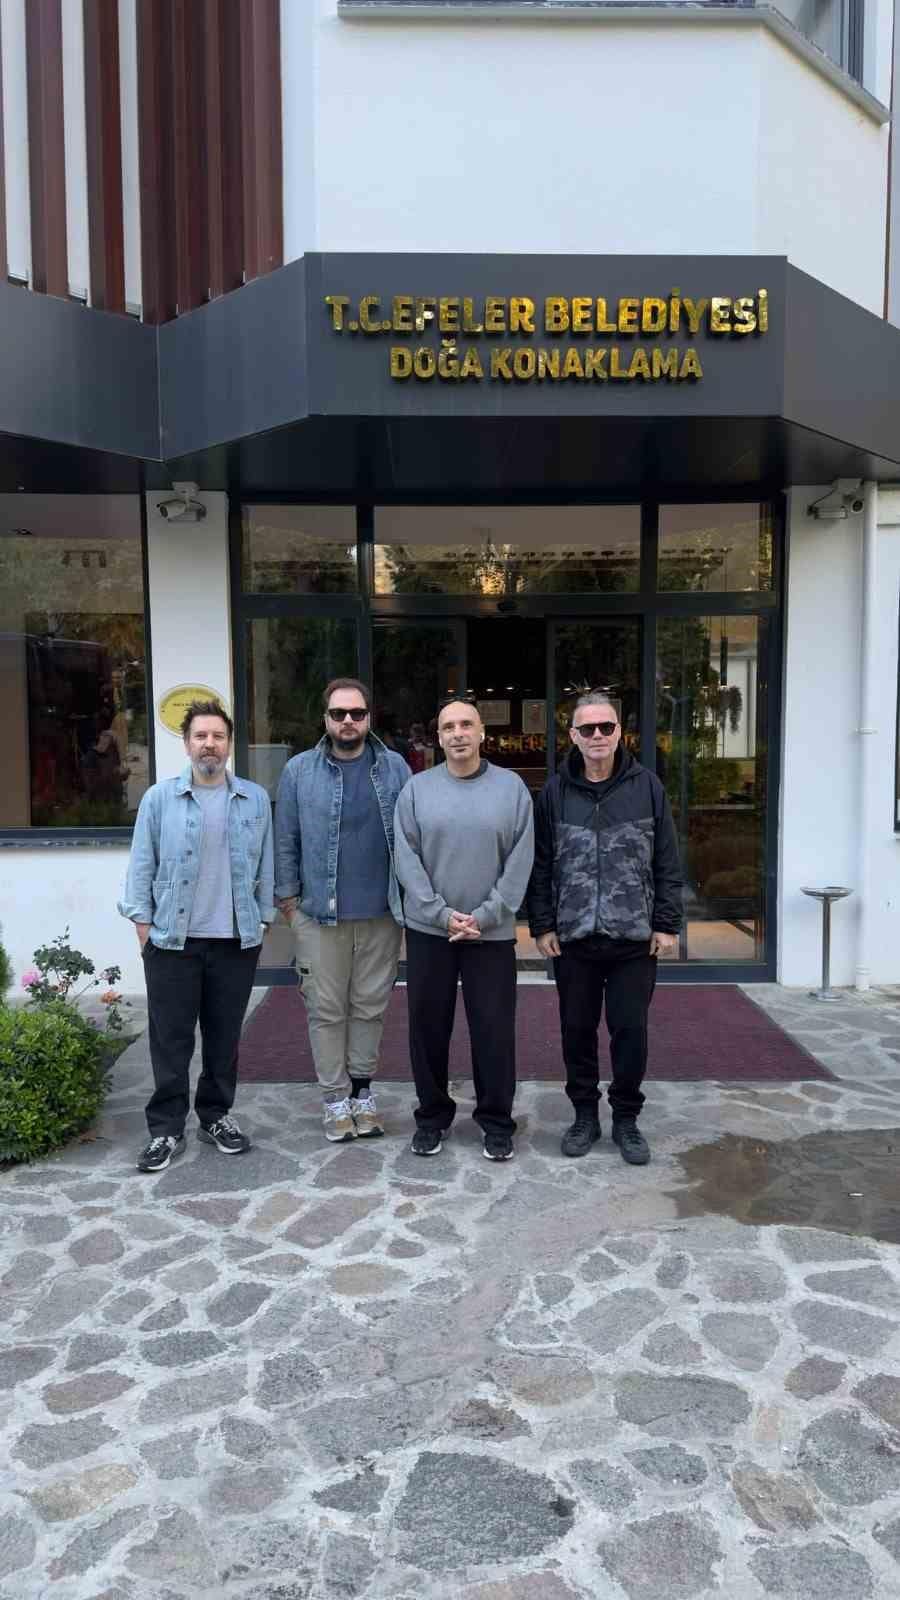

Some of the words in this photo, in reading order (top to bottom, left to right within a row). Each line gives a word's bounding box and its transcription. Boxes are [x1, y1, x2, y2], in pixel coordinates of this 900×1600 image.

[545, 287, 768, 332] BELEDİYESİ
[390, 337, 484, 379] DOĞA
[490, 348, 704, 379] KONAKLAMA
